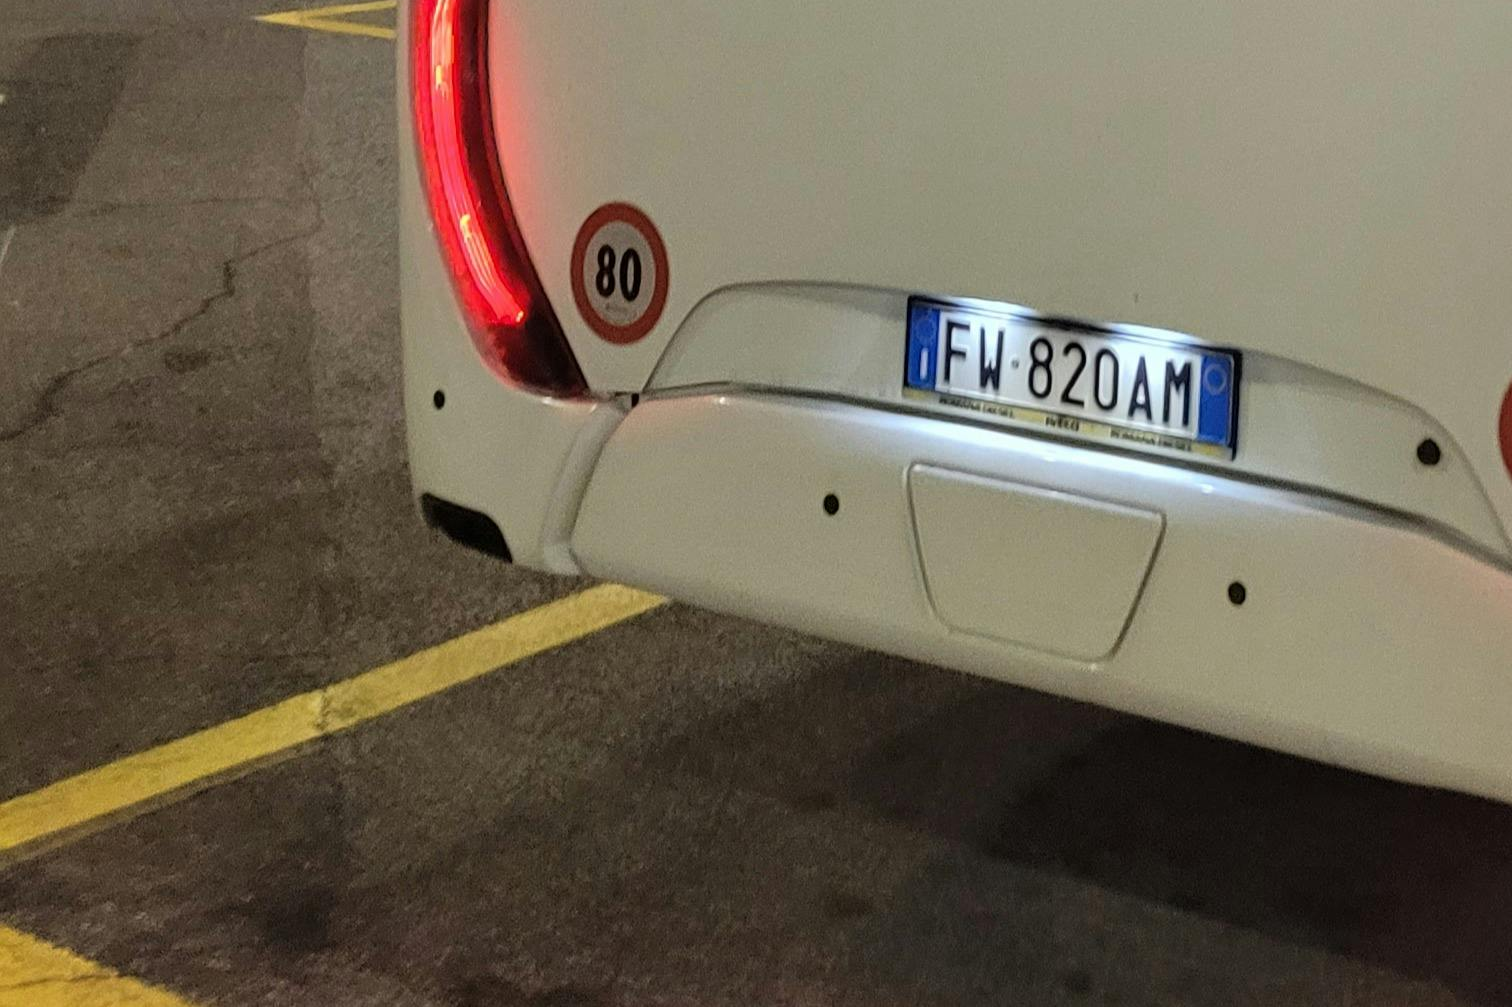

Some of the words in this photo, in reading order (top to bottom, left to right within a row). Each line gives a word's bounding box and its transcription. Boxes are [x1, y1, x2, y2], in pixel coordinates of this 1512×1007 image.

[595, 244, 642, 302] 80
[944, 318, 1005, 391] FW
[1027, 336, 1194, 429] 820AM
